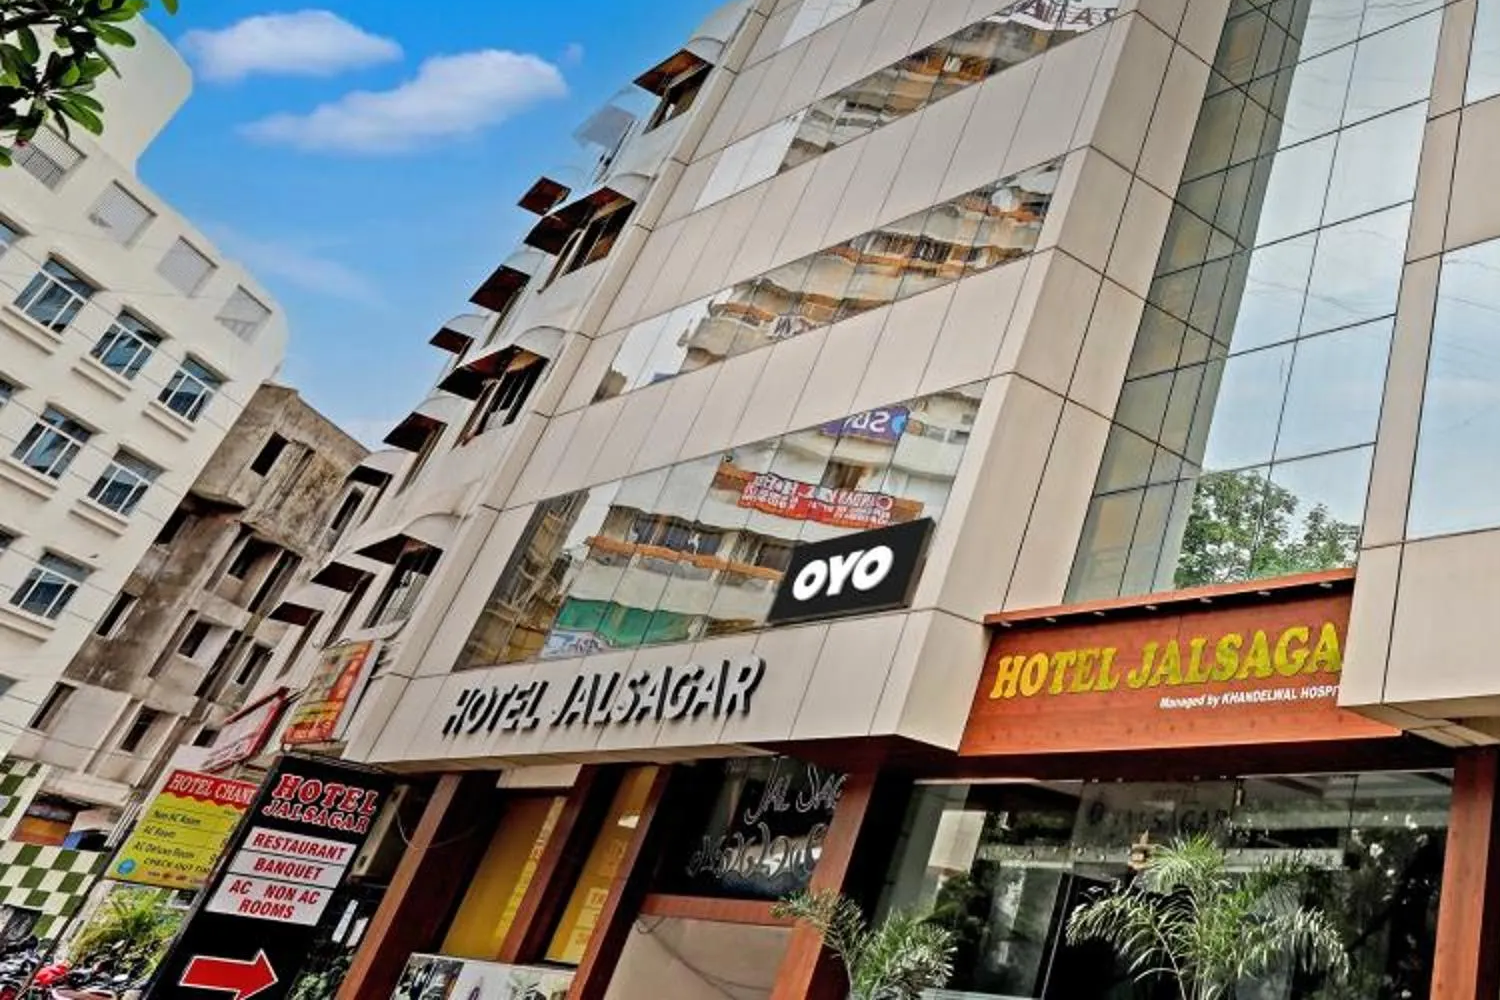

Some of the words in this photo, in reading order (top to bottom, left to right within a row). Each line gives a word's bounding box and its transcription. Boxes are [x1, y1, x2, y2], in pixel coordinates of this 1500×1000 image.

[792, 546, 895, 600] OYO
[989, 647, 1119, 699] HOTEL
[442, 680, 549, 736] HOTEL
[550, 655, 767, 727] JALSAGAR
[1159, 694, 1206, 710] Managed
[1207, 693, 1221, 708] by
[1221, 687, 1298, 705] KHANDELWAL
[169, 773, 213, 796] HOTEL
[272, 773, 379, 817] HOTEL
[261, 799, 371, 834] JALSAGAR
[252, 833, 348, 861] RESTAURANT
[253, 857, 324, 882] BANQUET
[228, 879, 252, 895] AC
[263, 883, 298, 900] NON
[298, 889, 321, 905] AC
[238, 898, 295, 920] ROOMS
